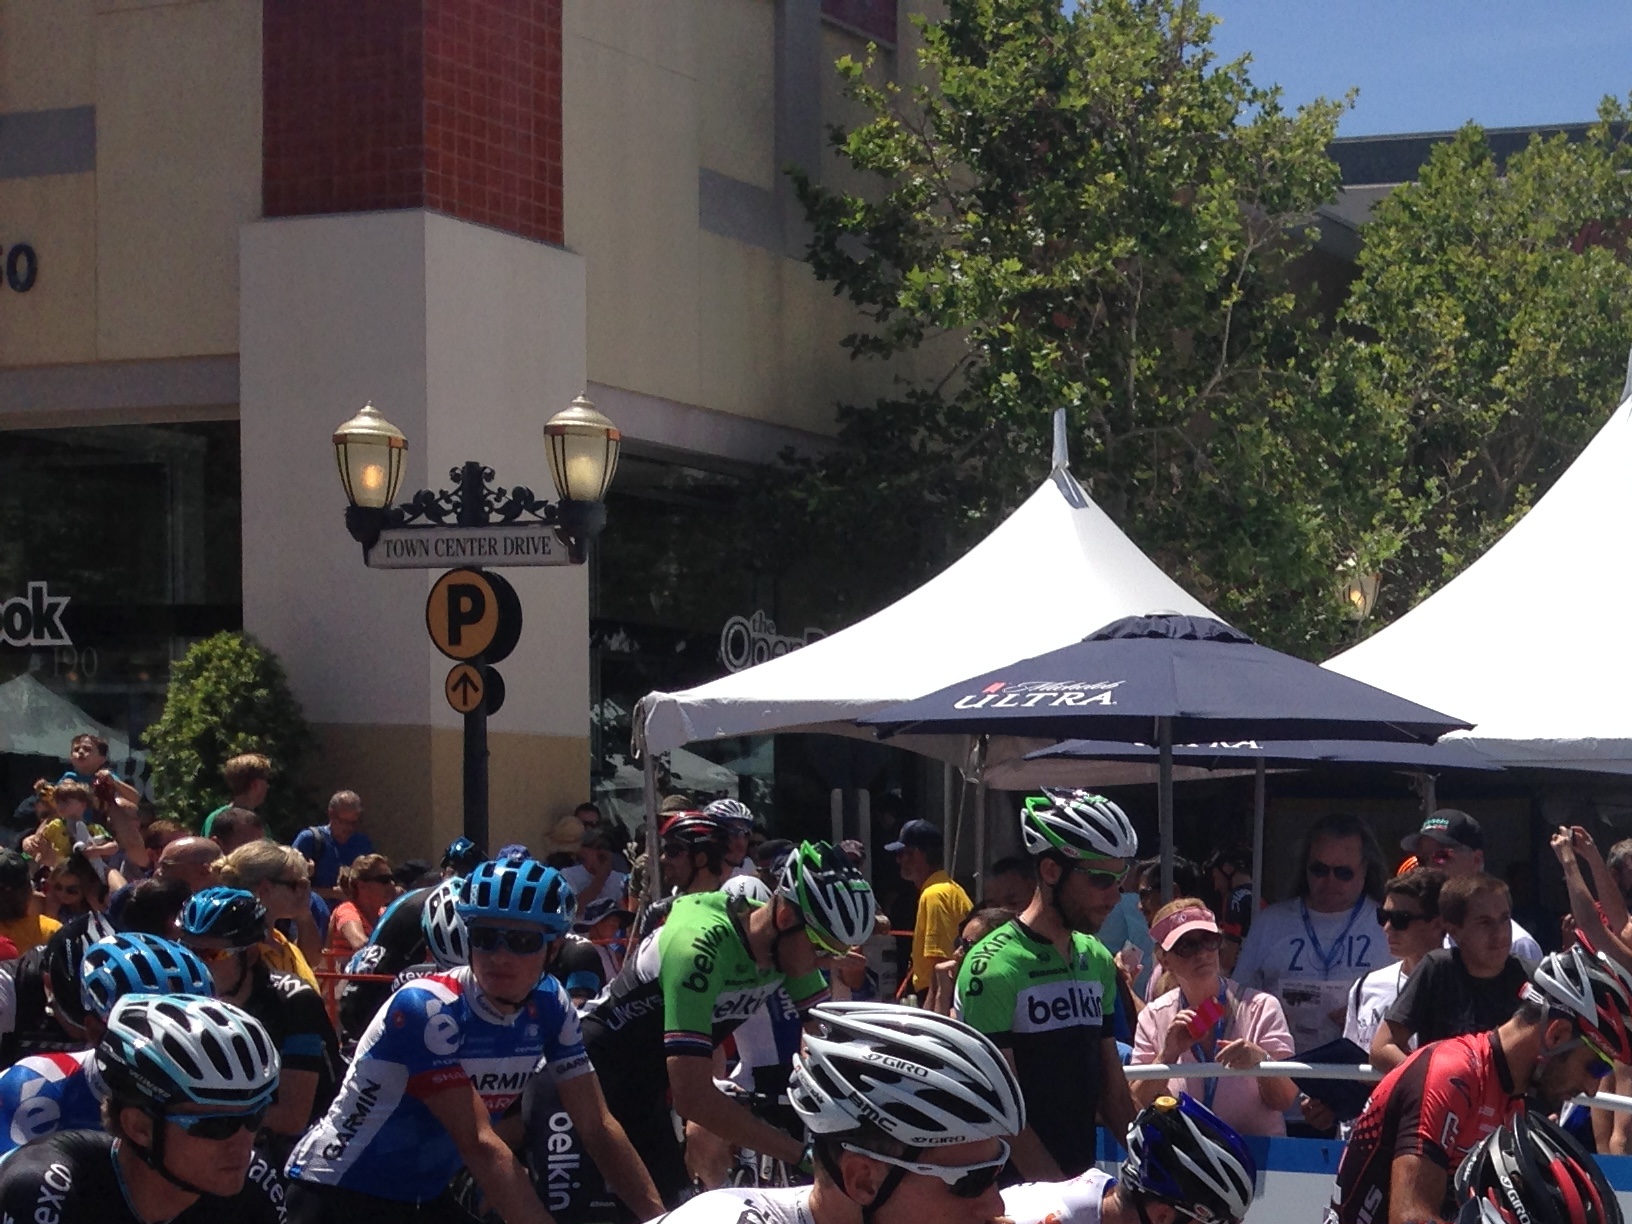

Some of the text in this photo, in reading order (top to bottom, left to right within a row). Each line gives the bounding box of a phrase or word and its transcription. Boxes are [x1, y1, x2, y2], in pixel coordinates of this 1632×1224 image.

[0, 243, 38, 293] 0
[384, 536, 552, 558] TOWN CENTER DRIVE
[0, 581, 73, 647] ok
[447, 583, 486, 646] P
[752, 609, 776, 634] the
[954, 690, 1114, 709] ULTRA
[682, 922, 730, 994] belkin
[965, 931, 1013, 997] belkin
[882, 1057, 929, 1078] GIRO
[322, 1079, 381, 1161] GARMIN
[849, 1090, 898, 1132] BMC
